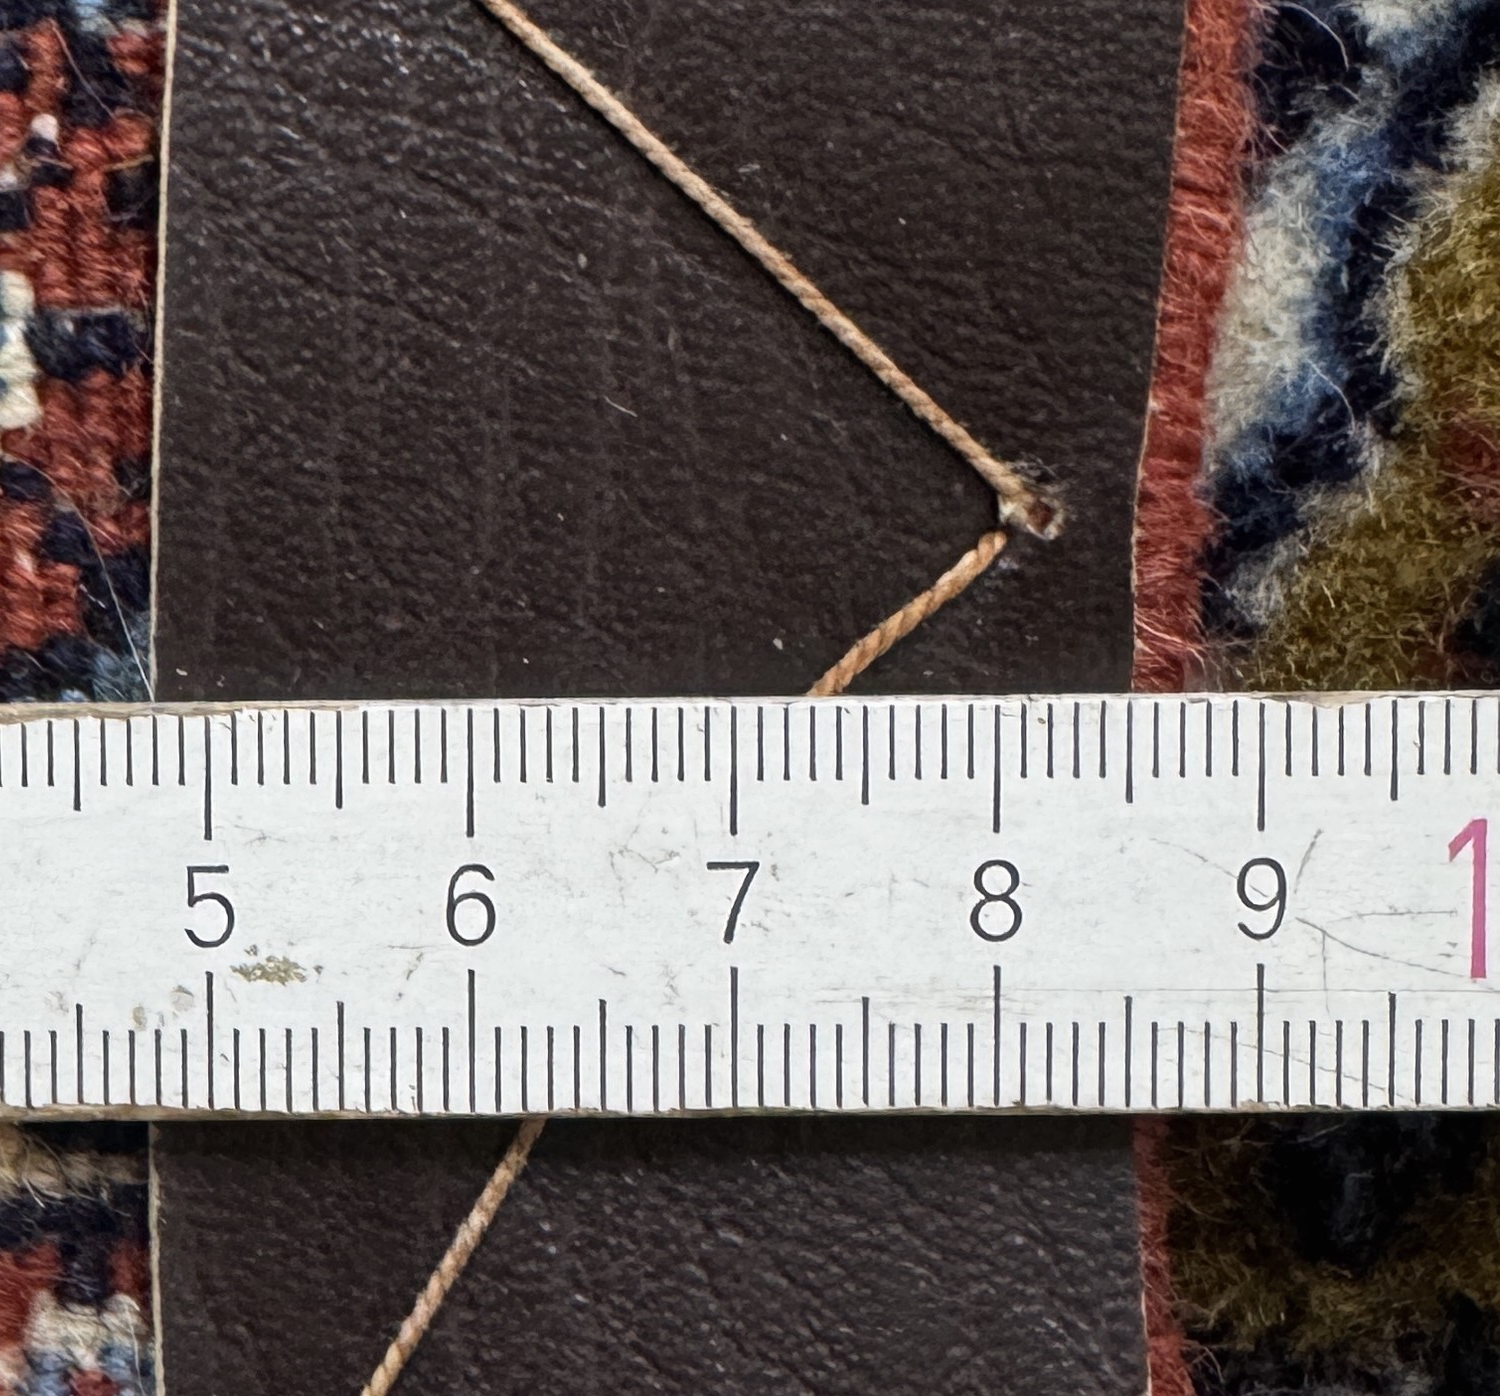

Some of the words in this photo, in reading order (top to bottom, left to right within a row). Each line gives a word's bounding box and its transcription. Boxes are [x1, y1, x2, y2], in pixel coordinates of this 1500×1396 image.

[184, 864, 235, 949] 5
[446, 863, 496, 947] 6
[706, 861, 760, 945] 7
[969, 859, 1023, 943] 8
[1236, 857, 1287, 941] 9
[1447, 818, 1488, 979] 1
